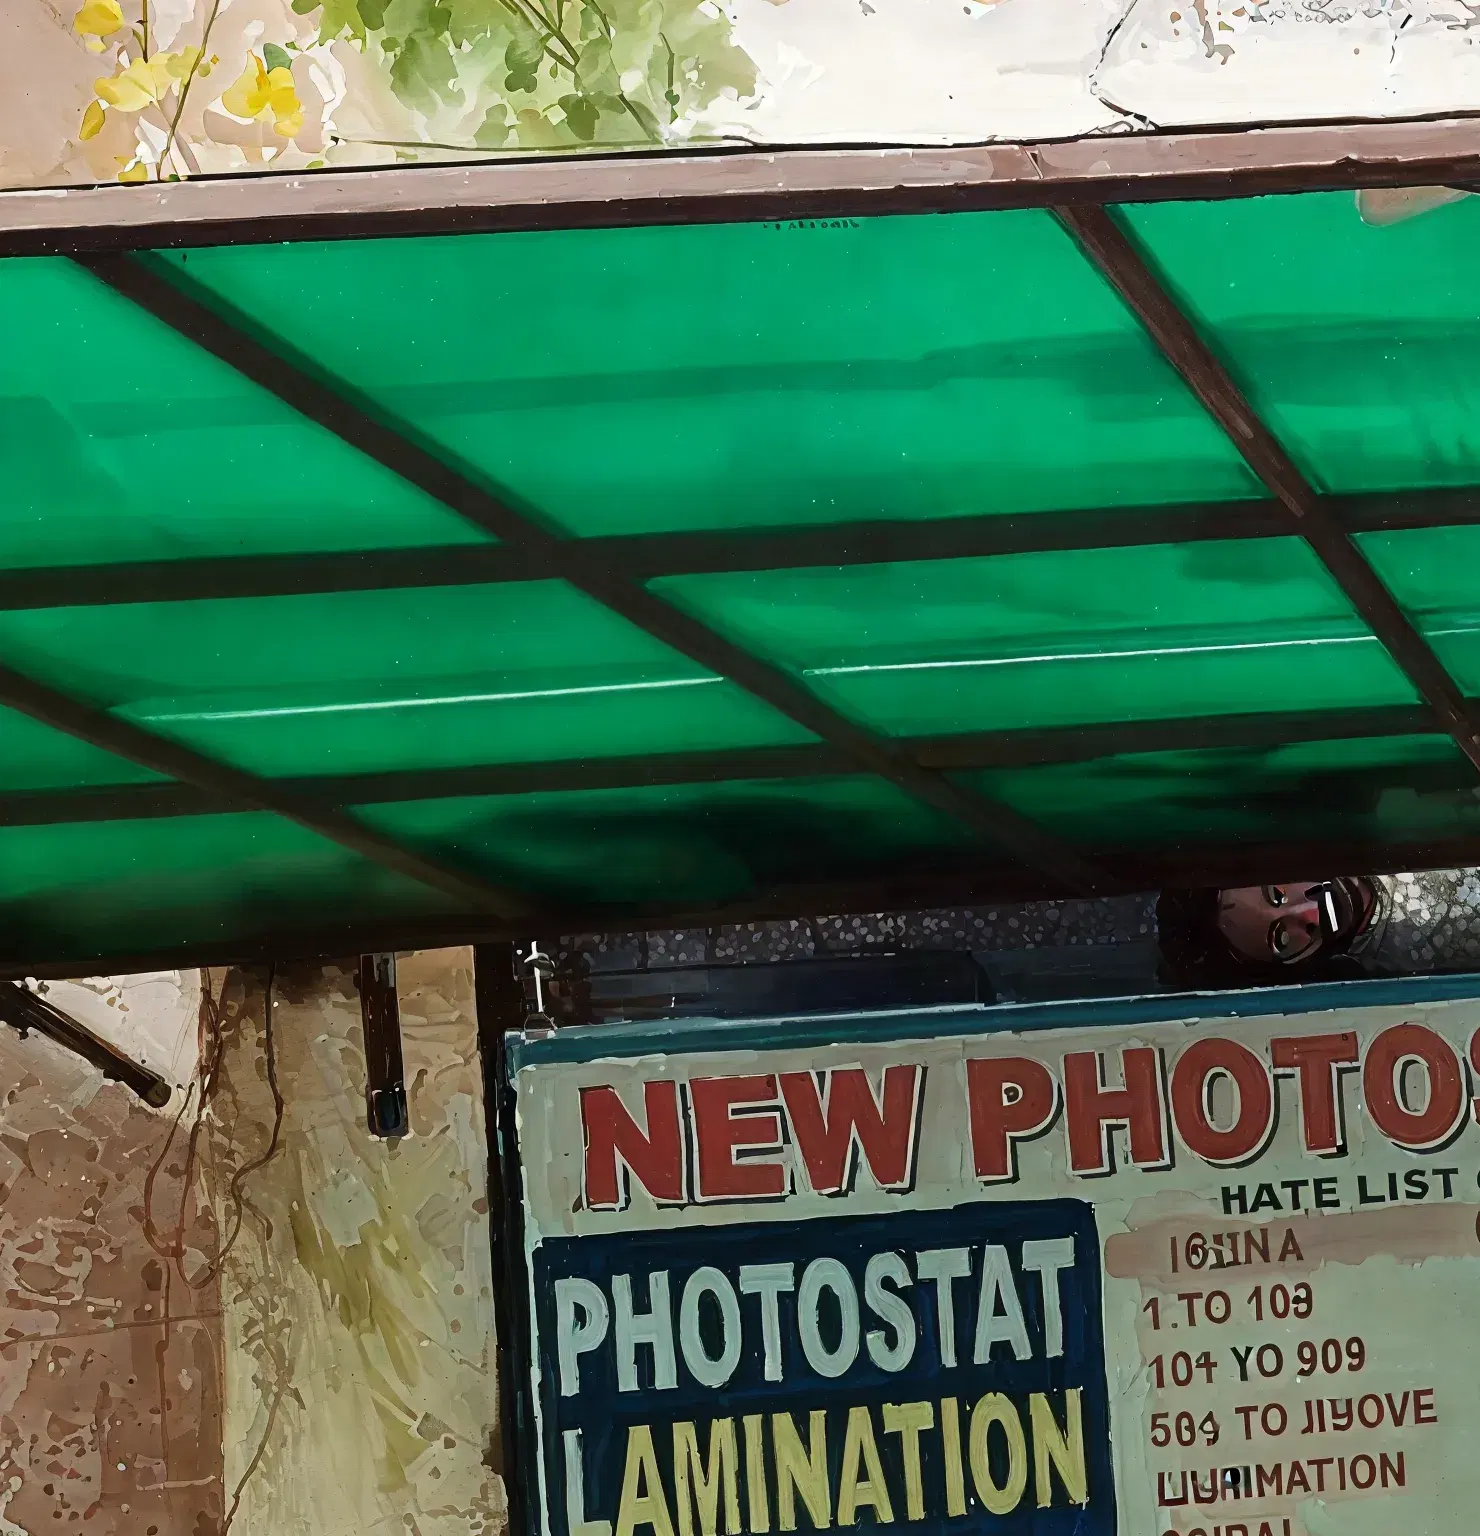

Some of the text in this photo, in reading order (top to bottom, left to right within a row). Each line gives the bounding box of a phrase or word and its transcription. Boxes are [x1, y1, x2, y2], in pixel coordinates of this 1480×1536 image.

[579, 1062, 927, 1211] NEW
[1357, 1167, 1459, 1205] LIST
[554, 1236, 1076, 1398] PHOTOSTAT
[1234, 1402, 1288, 1441] TO
